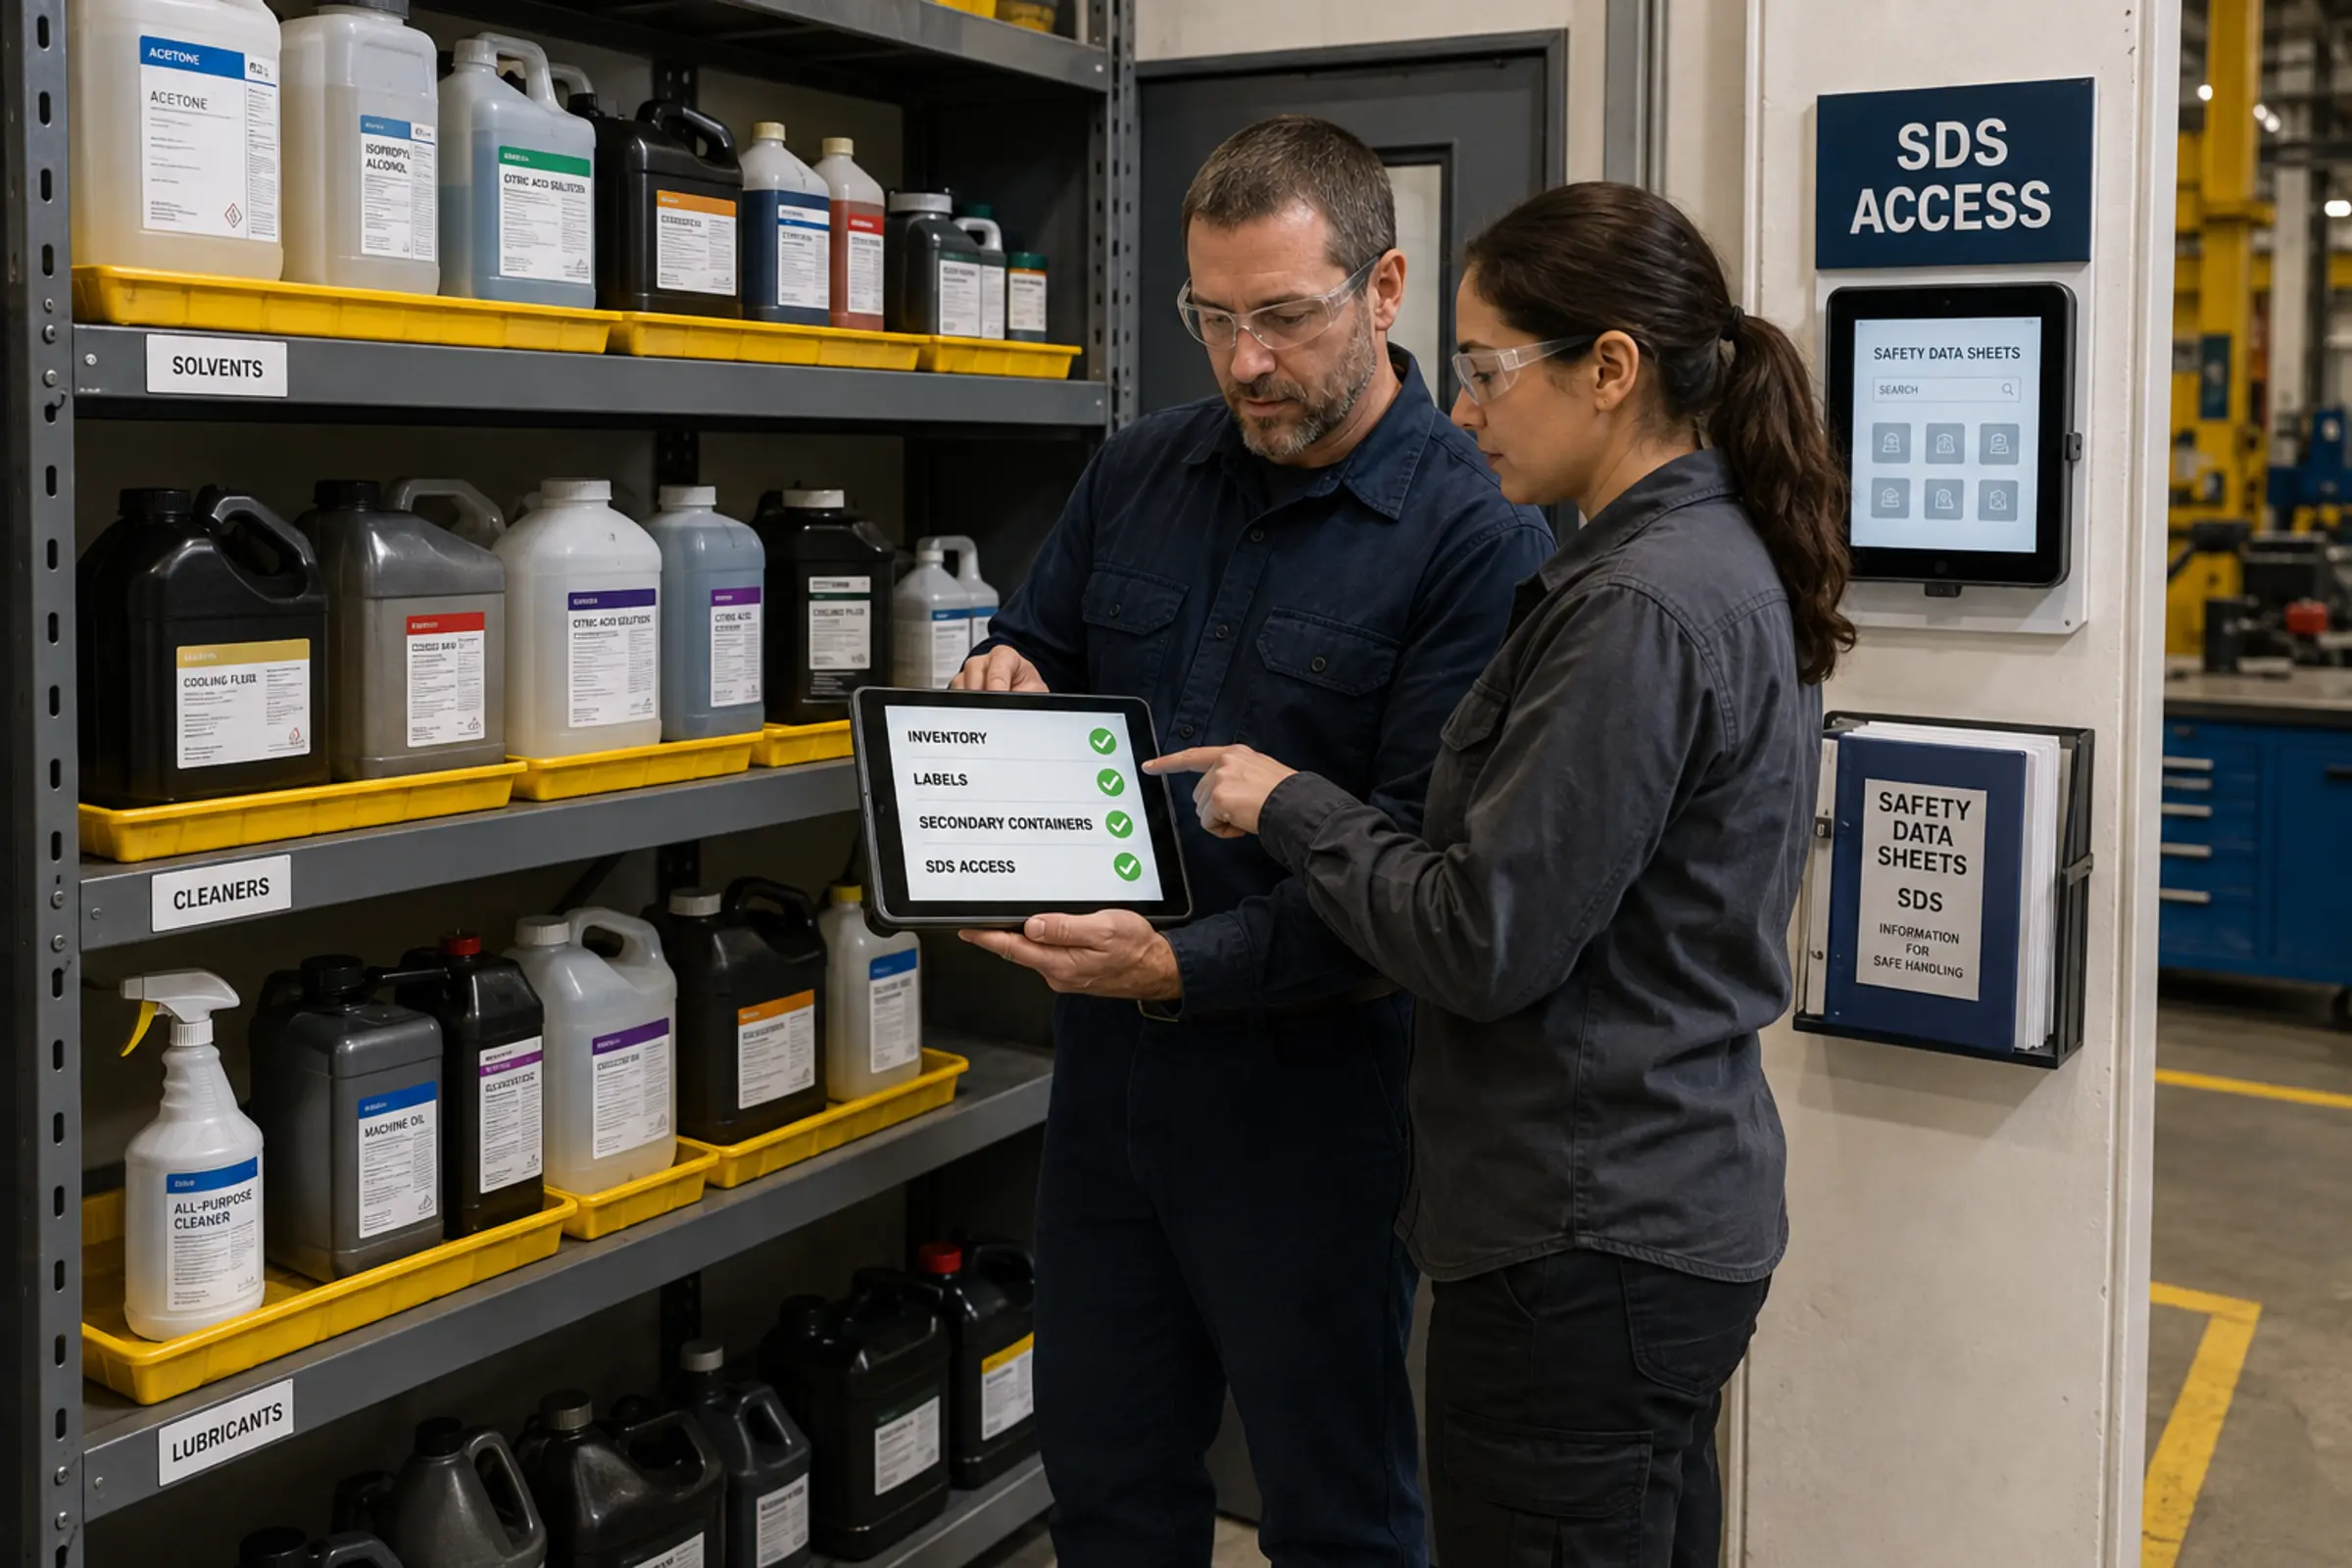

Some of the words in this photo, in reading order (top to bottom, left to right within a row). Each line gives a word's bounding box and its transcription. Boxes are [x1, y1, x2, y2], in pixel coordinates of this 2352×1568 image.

[149, 47, 200, 66] ACETONE
[150, 90, 208, 110] ACETONE
[1896, 118, 2009, 171] SDS
[1849, 180, 2051, 234] ACCESS
[1873, 347, 1925, 361] SAFETY
[1929, 346, 1964, 360] DATA
[1967, 346, 2022, 360] SHEETS
[172, 356, 264, 378] SOLVENTS
[1879, 384, 1919, 396] SEARCH
[183, 674, 228, 688] COOLING
[907, 730, 988, 745] INVENTORY
[913, 772, 968, 787] LABELS
[1879, 791, 1972, 821] SAFETY
[919, 815, 1005, 830] SECONDARY
[1007, 816, 1094, 831] CONTAINERS
[1893, 819, 1954, 848] DATA
[926, 859, 956, 874] SDS
[959, 859, 1016, 874] ACCESS
[1878, 845, 1968, 876] SHEETS
[173, 876, 270, 910] CLEANERS
[1897, 887, 1943, 913] SDS
[1879, 922, 1960, 945] INFORMATION
[1905, 943, 1931, 957] FOR
[1873, 955, 1903, 970] SAFE
[1905, 959, 1964, 979] HANDLING
[364, 1117, 409, 1138] MACHINE
[173, 1188, 253, 1215] ALL-PURPOSE
[173, 1211, 231, 1230] CLEANER
[172, 1402, 283, 1463] LUBRICANTS
